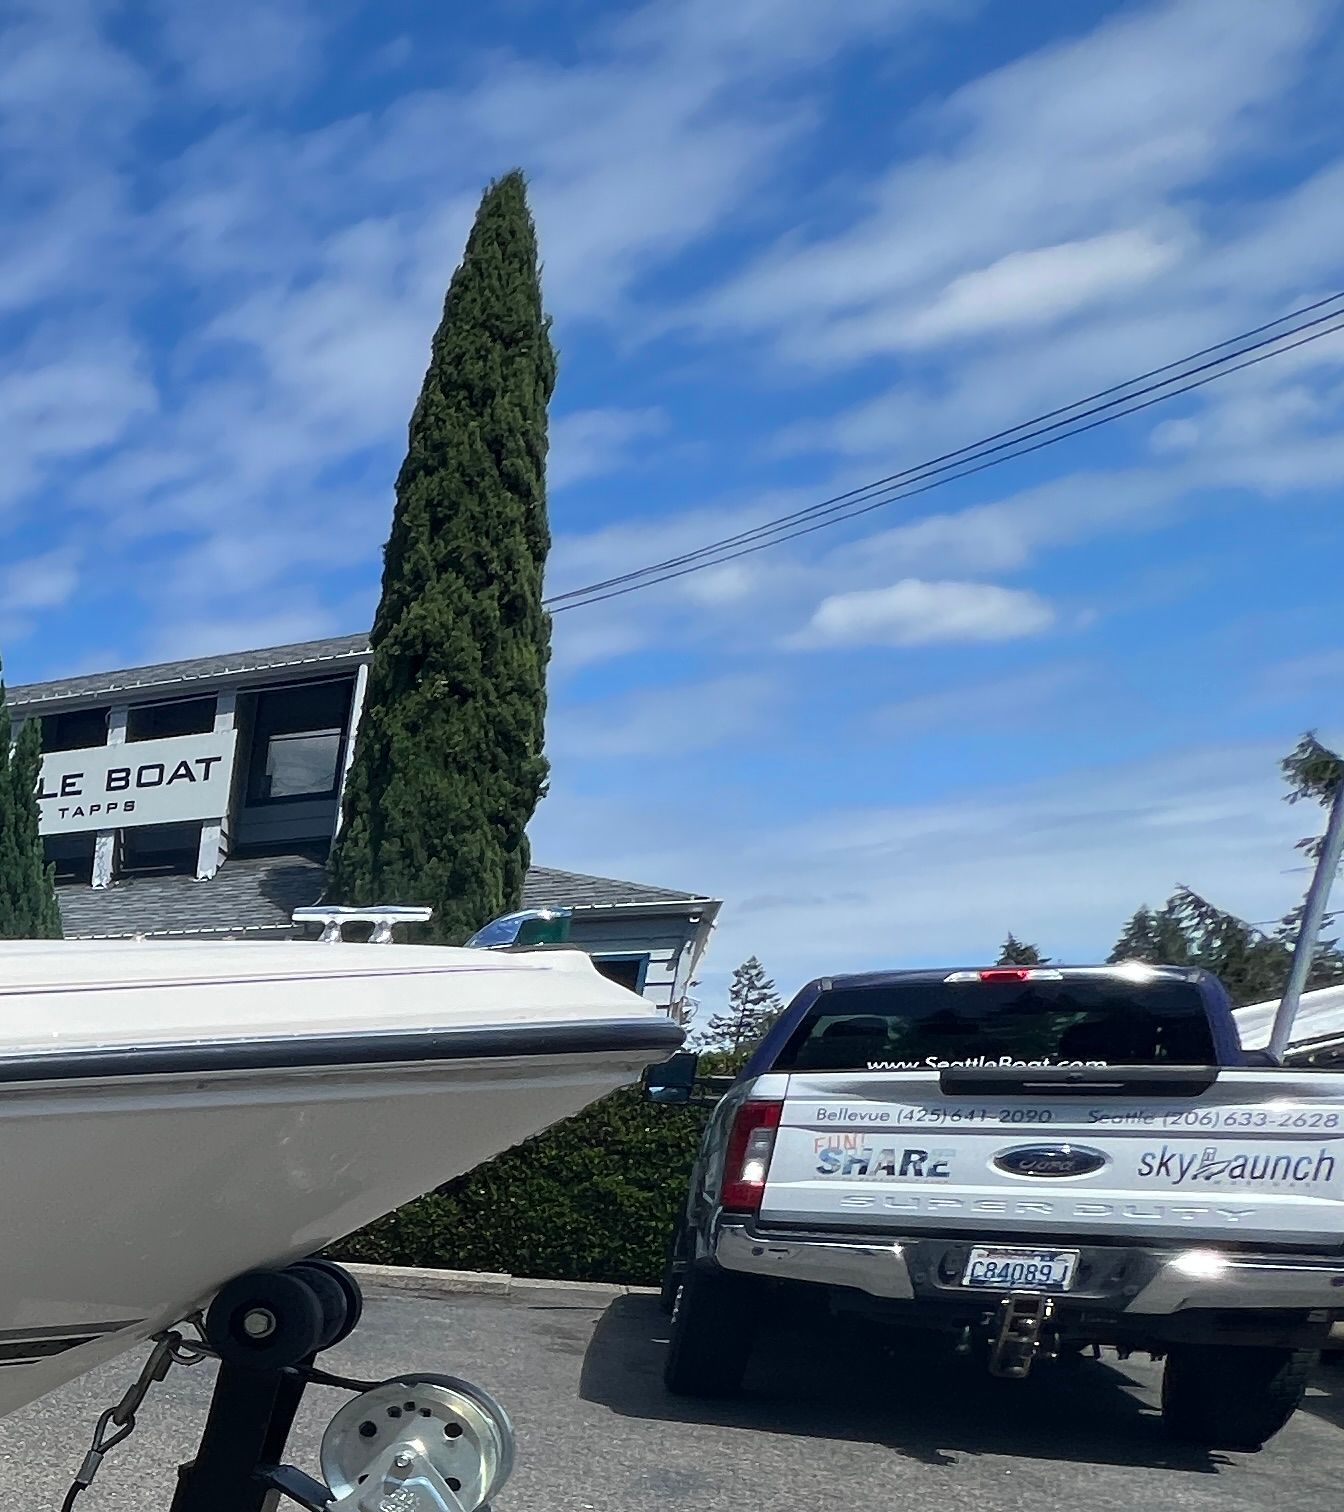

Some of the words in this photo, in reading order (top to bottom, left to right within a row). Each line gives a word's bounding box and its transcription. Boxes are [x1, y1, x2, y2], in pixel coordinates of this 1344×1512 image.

[105, 756, 222, 792] BOAT
[58, 800, 136, 819] TAPPS
[815, 1107, 890, 1122] Bellevue
[1088, 1109, 1154, 1125] Seattle
[815, 1148, 957, 1178] SHARE
[840, 1194, 1054, 1216] SUPER
[1073, 1202, 1257, 1222] DUTY
[971, 1260, 1069, 1283] C84089J
